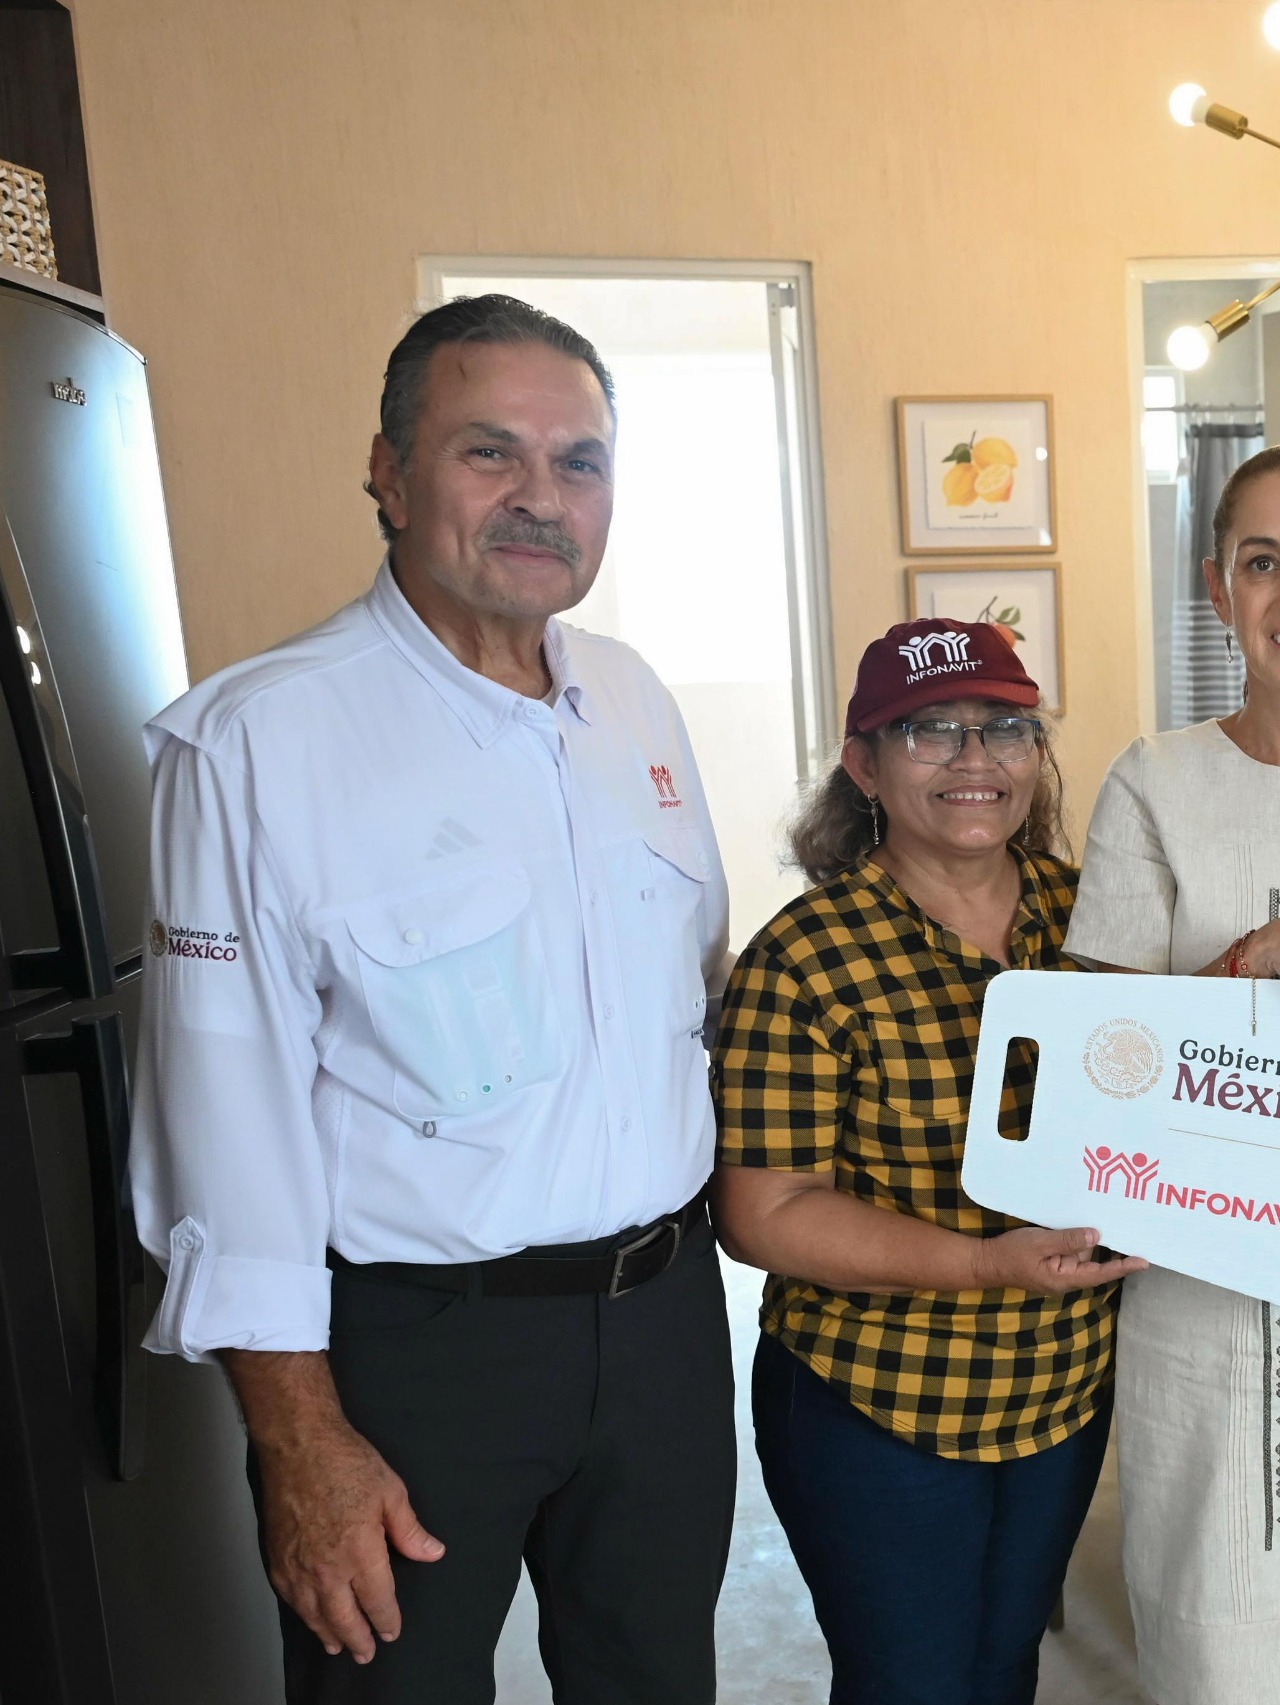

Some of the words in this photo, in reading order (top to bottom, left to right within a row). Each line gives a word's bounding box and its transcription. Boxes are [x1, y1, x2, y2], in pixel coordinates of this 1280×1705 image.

[906, 661, 977, 685] INFONAVIT
[168, 926, 219, 941] Gobierno
[224, 932, 240, 943] de
[168, 937, 237, 962] México
[1085, 1023, 1108, 1051] ESTADOS
[1109, 1017, 1138, 1027] UNIDOS
[1139, 1024, 1164, 1063] MEXICANOS
